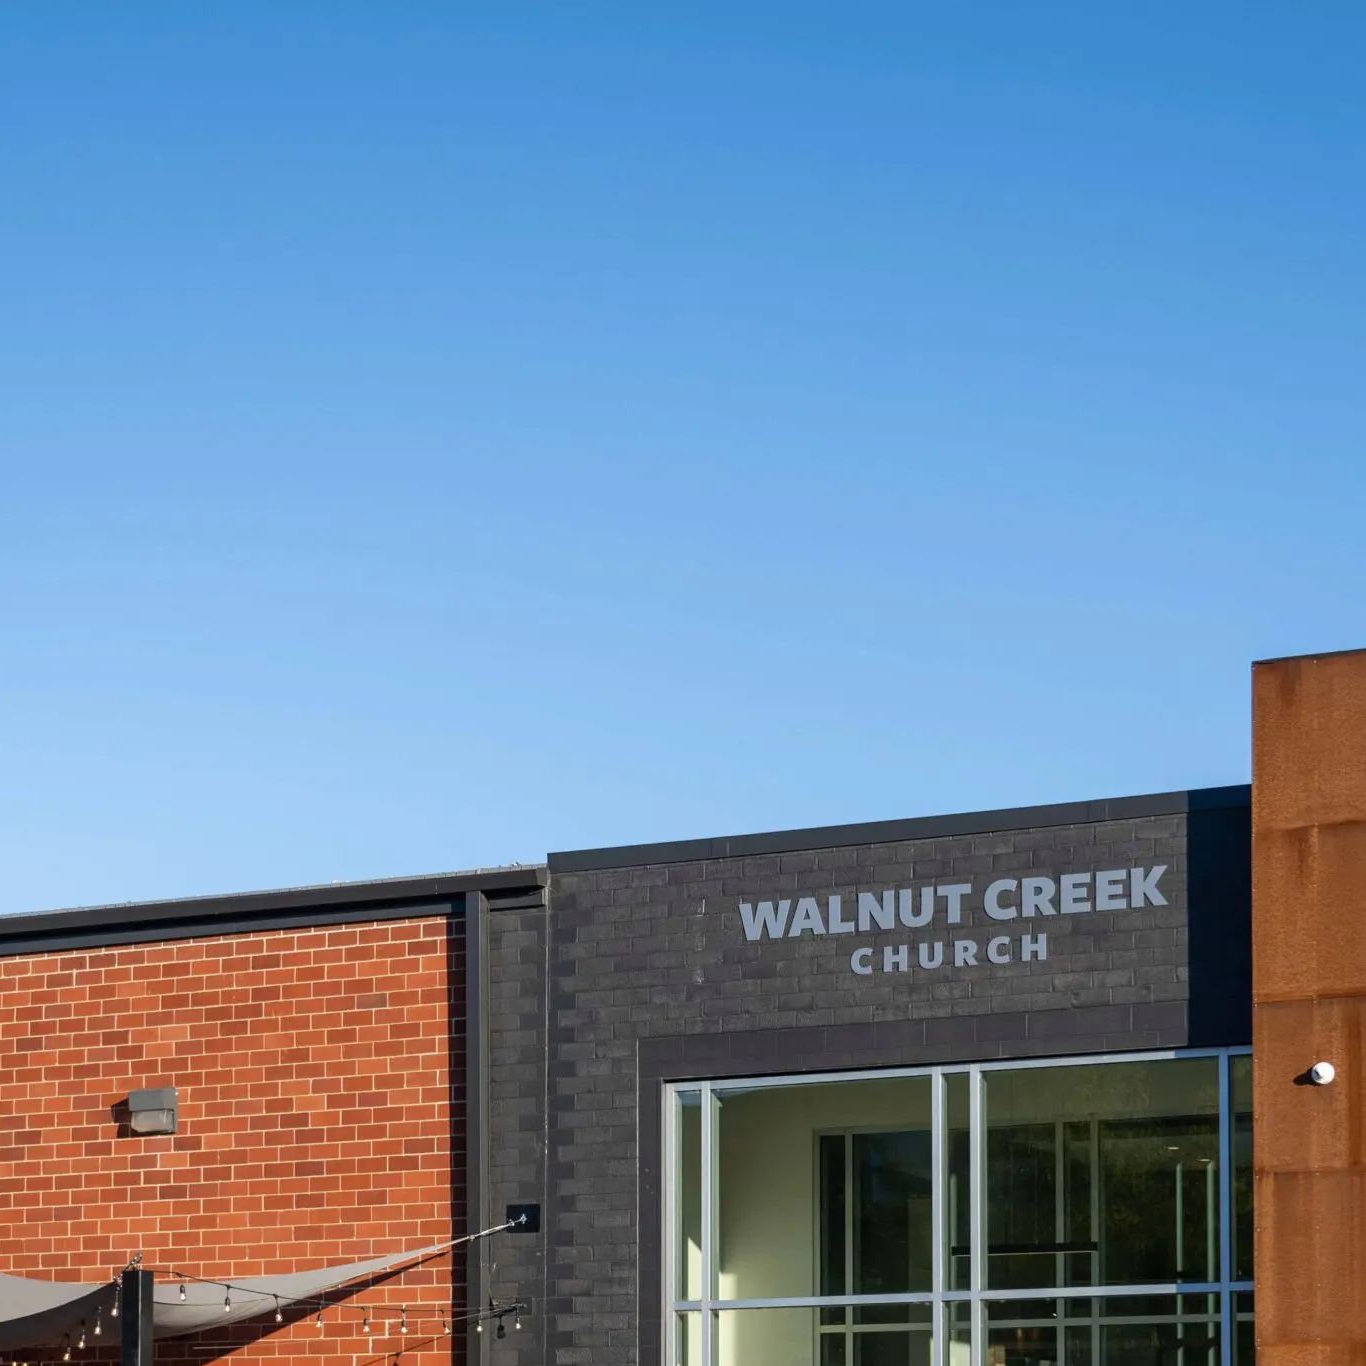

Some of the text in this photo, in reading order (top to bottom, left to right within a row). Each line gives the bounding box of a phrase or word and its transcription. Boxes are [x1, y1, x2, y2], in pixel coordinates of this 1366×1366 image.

[739, 865, 1169, 941] WALNUT CREEK
[850, 933, 1048, 975] CHURCH
